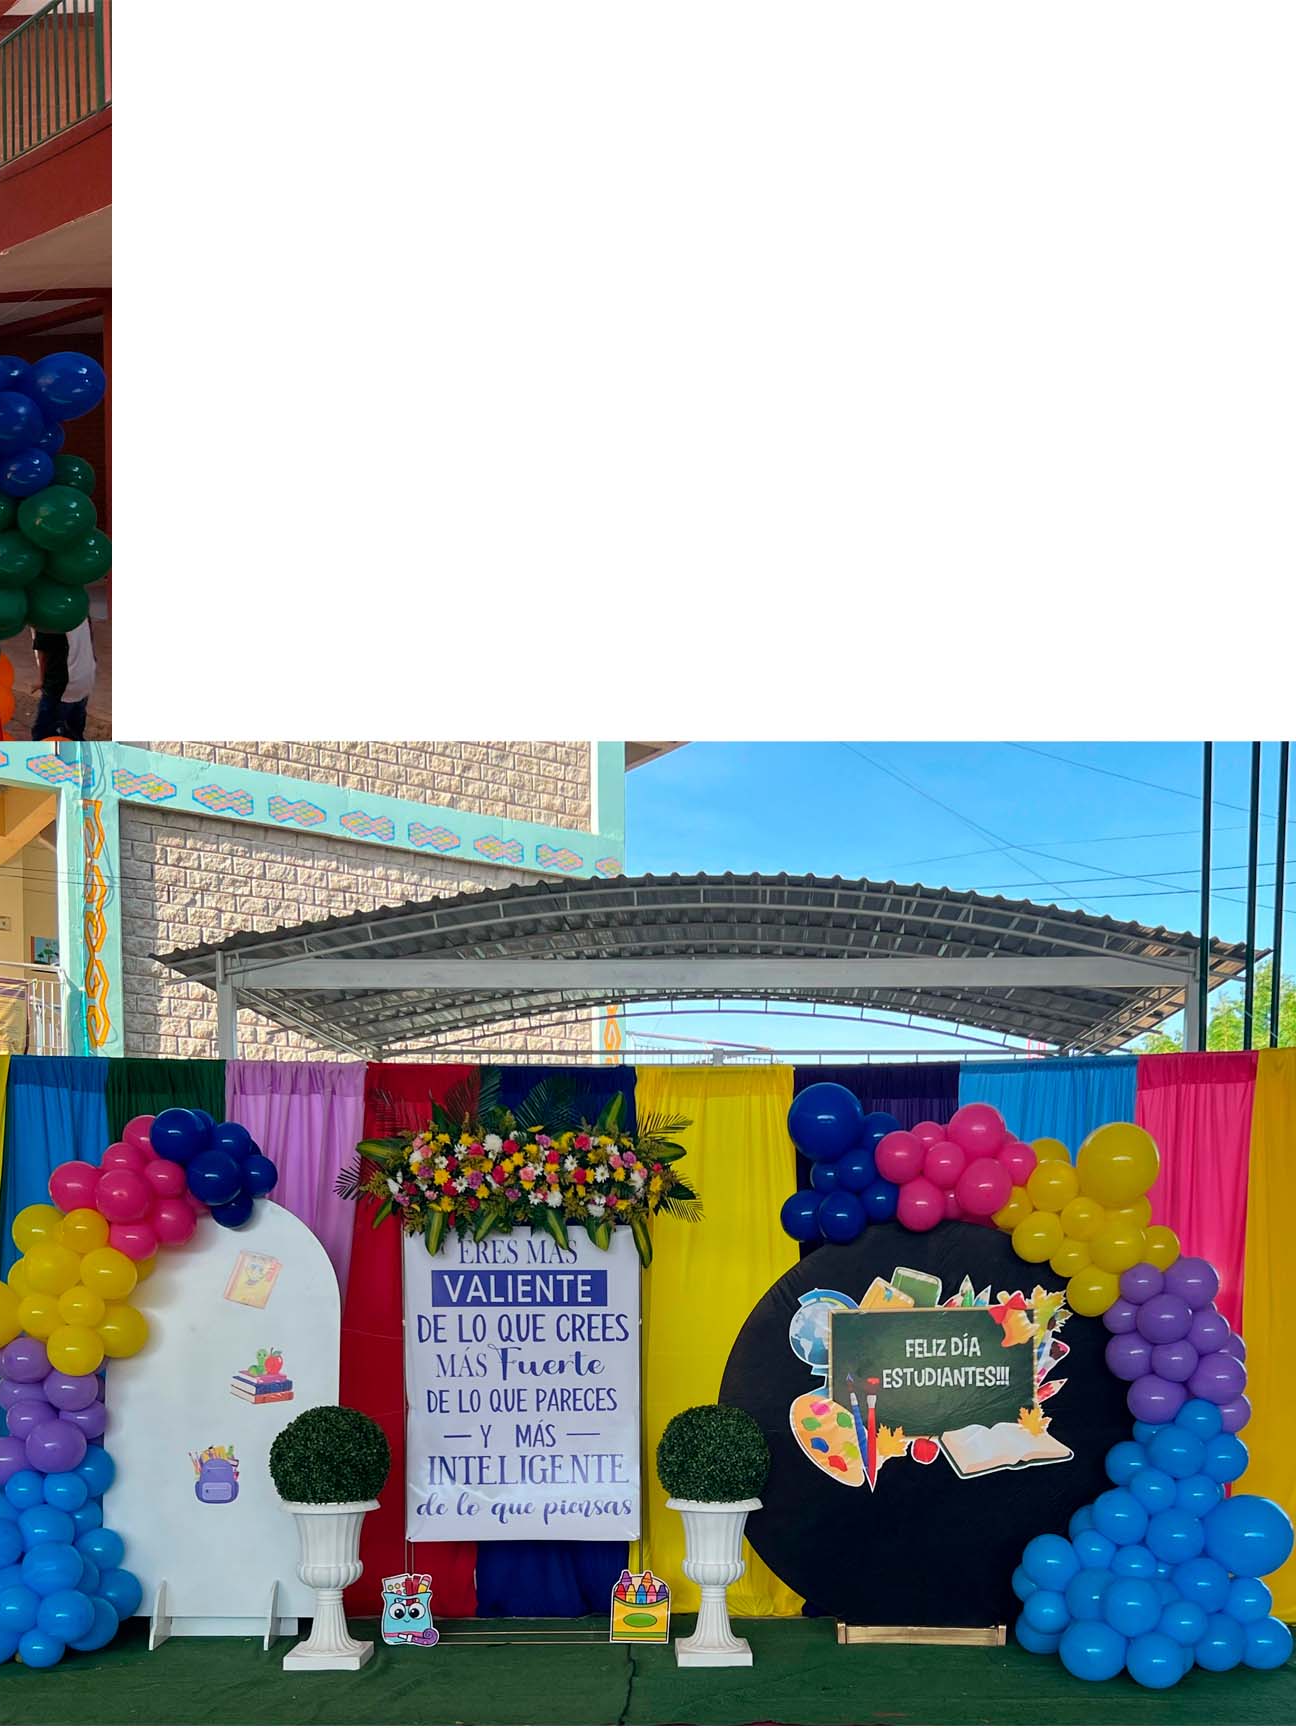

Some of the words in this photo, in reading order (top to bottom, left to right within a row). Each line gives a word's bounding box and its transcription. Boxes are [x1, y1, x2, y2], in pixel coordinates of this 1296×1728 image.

[459, 1239, 519, 1265] ERES
[442, 1274, 593, 1303] VALIENTE
[416, 1314, 447, 1344] DE
[458, 1314, 487, 1343] LO
[497, 1313, 546, 1344] QUE
[555, 1313, 630, 1343] CREES
[905, 1338, 947, 1358] FELIZ
[950, 1332, 982, 1358] DÍA
[435, 1346, 488, 1378] MÁS
[487, 1343, 605, 1381] Fuerte
[882, 1366, 1010, 1389] ESTUDIANTES!!!
[426, 1389, 451, 1414] DE
[458, 1388, 481, 1413] LO
[489, 1388, 529, 1413] QUE
[535, 1387, 618, 1413] PARECES
[480, 1424, 492, 1449] Y
[515, 1419, 557, 1448] MÁS
[427, 1453, 630, 1486] INTELIGENTE
[416, 1491, 449, 1517] de
[456, 1491, 481, 1516] lo
[490, 1500, 537, 1525] que
[542, 1498, 633, 1526] piensas
